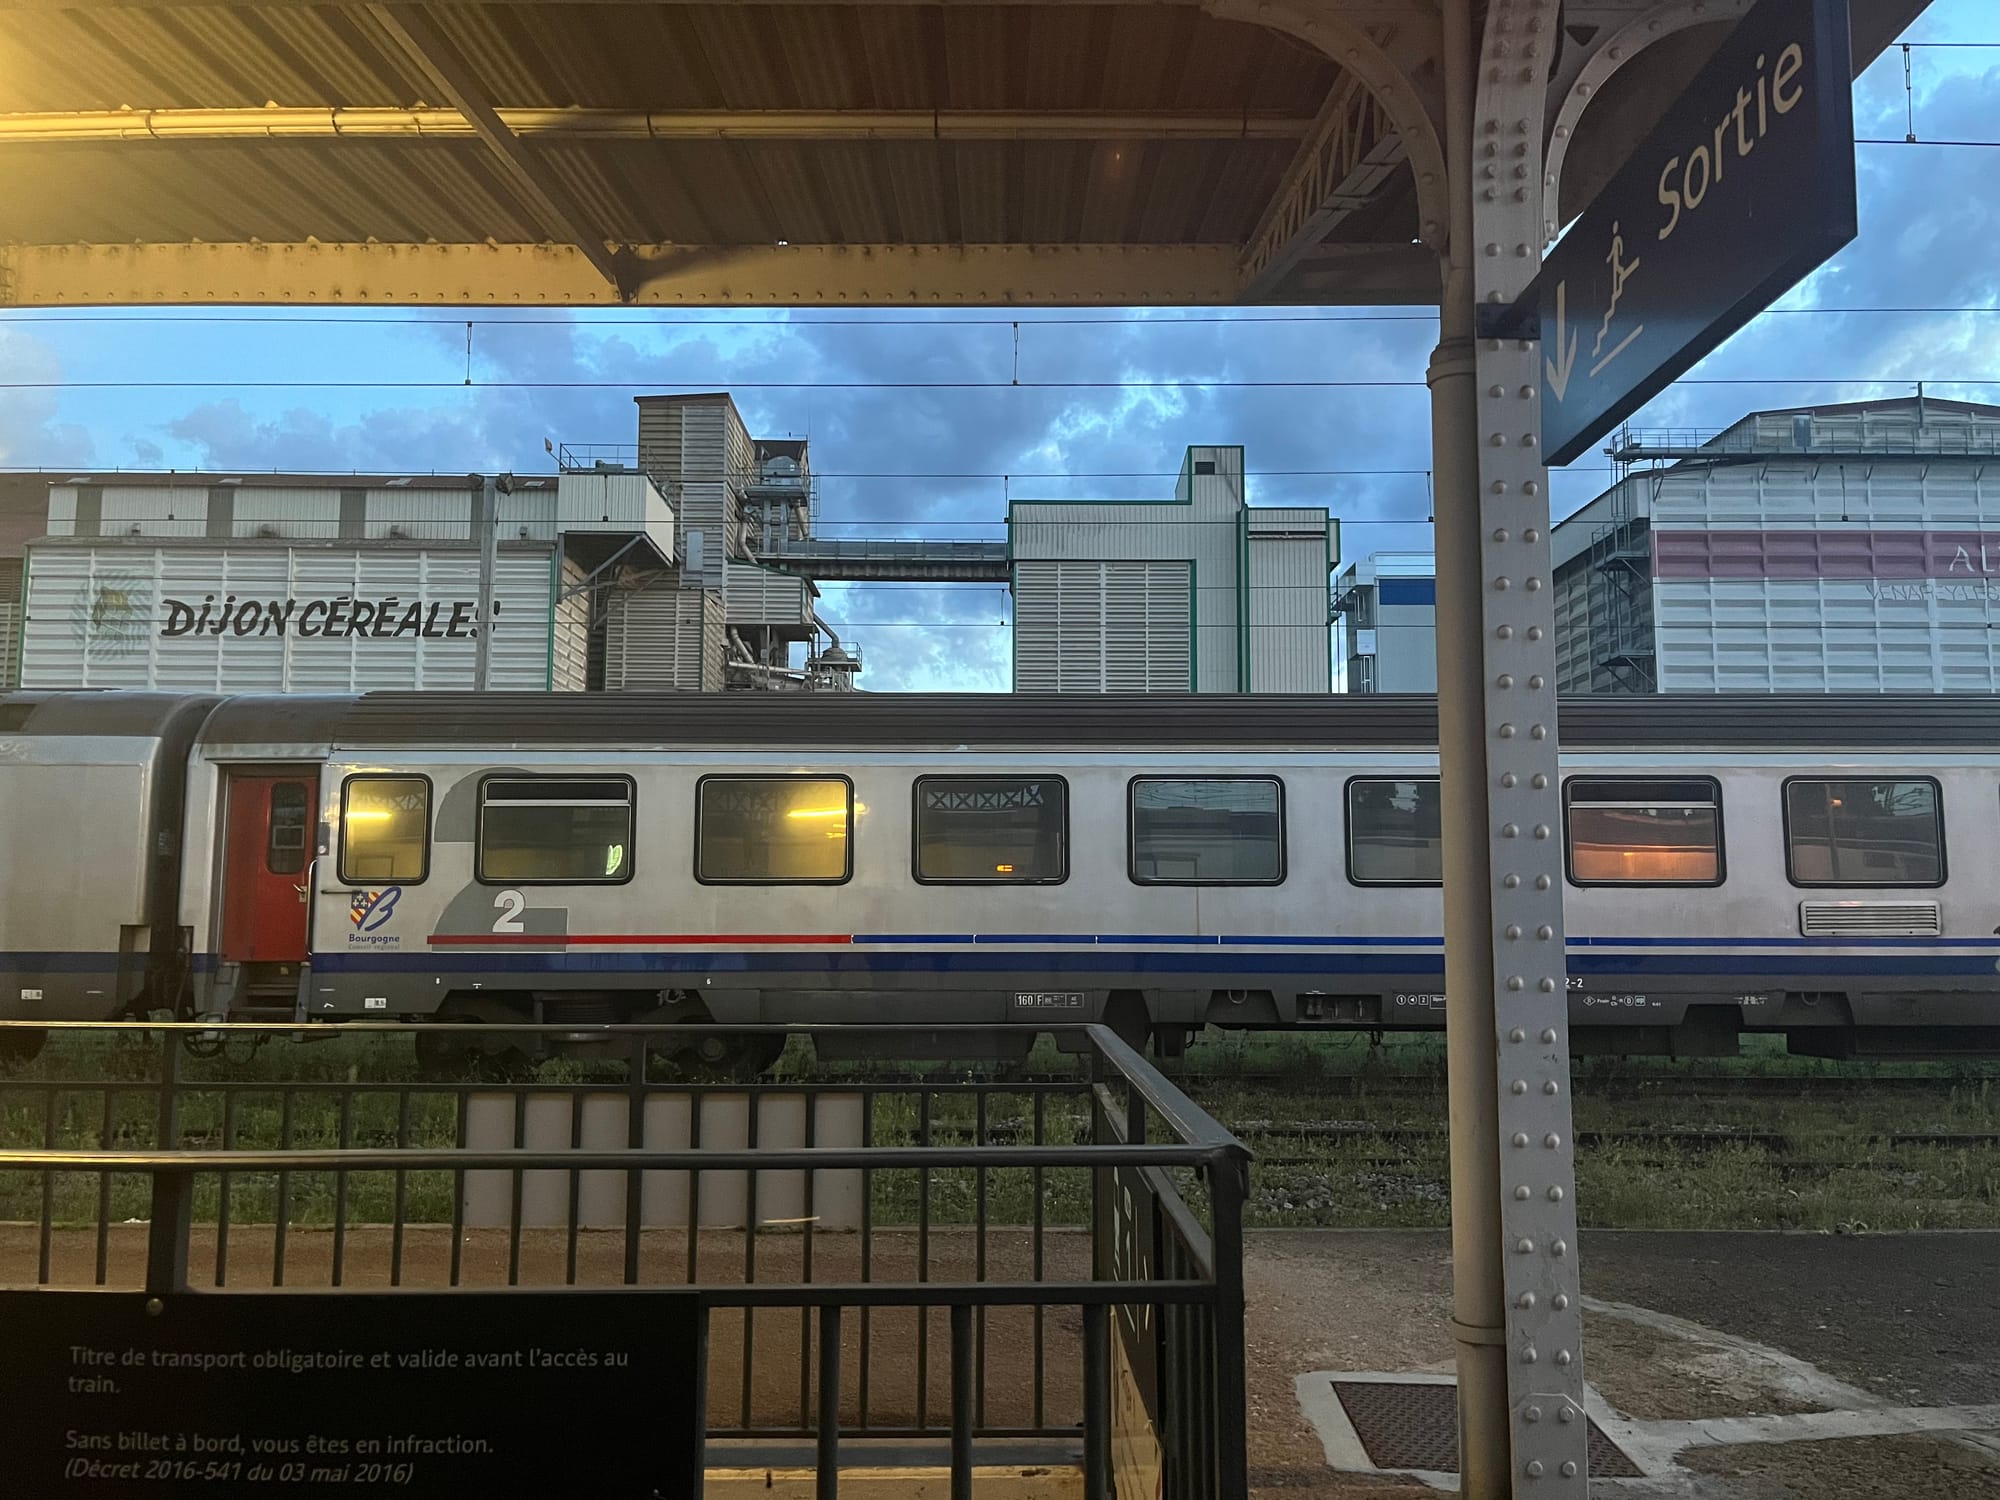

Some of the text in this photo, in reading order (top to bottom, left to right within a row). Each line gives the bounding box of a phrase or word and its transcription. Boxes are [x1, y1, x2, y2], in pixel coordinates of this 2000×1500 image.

[1657, 42, 1803, 241] Sortie
[1949, 545, 2000, 572] AL
[492, 889, 525, 933] 2
[348, 933, 400, 944] Bourgogne
[1018, 995, 1033, 1006] 160
[70, 1346, 115, 1366] Titre
[121, 1348, 145, 1366] de
[152, 1351, 245, 1371] transport
[253, 1350, 364, 1373] obligatoire
[370, 1352, 391, 1368] et
[398, 1350, 459, 1368] valide
[464, 1351, 522, 1368] avant
[604, 1352, 628, 1367] au
[68, 1375, 119, 1393] train.
[66, 1430, 493, 1455] Sans billet à bord, vous êtes en infraction.
[64, 1459, 414, 1485] (Décret 2016-541 du 03 mai 2016)
